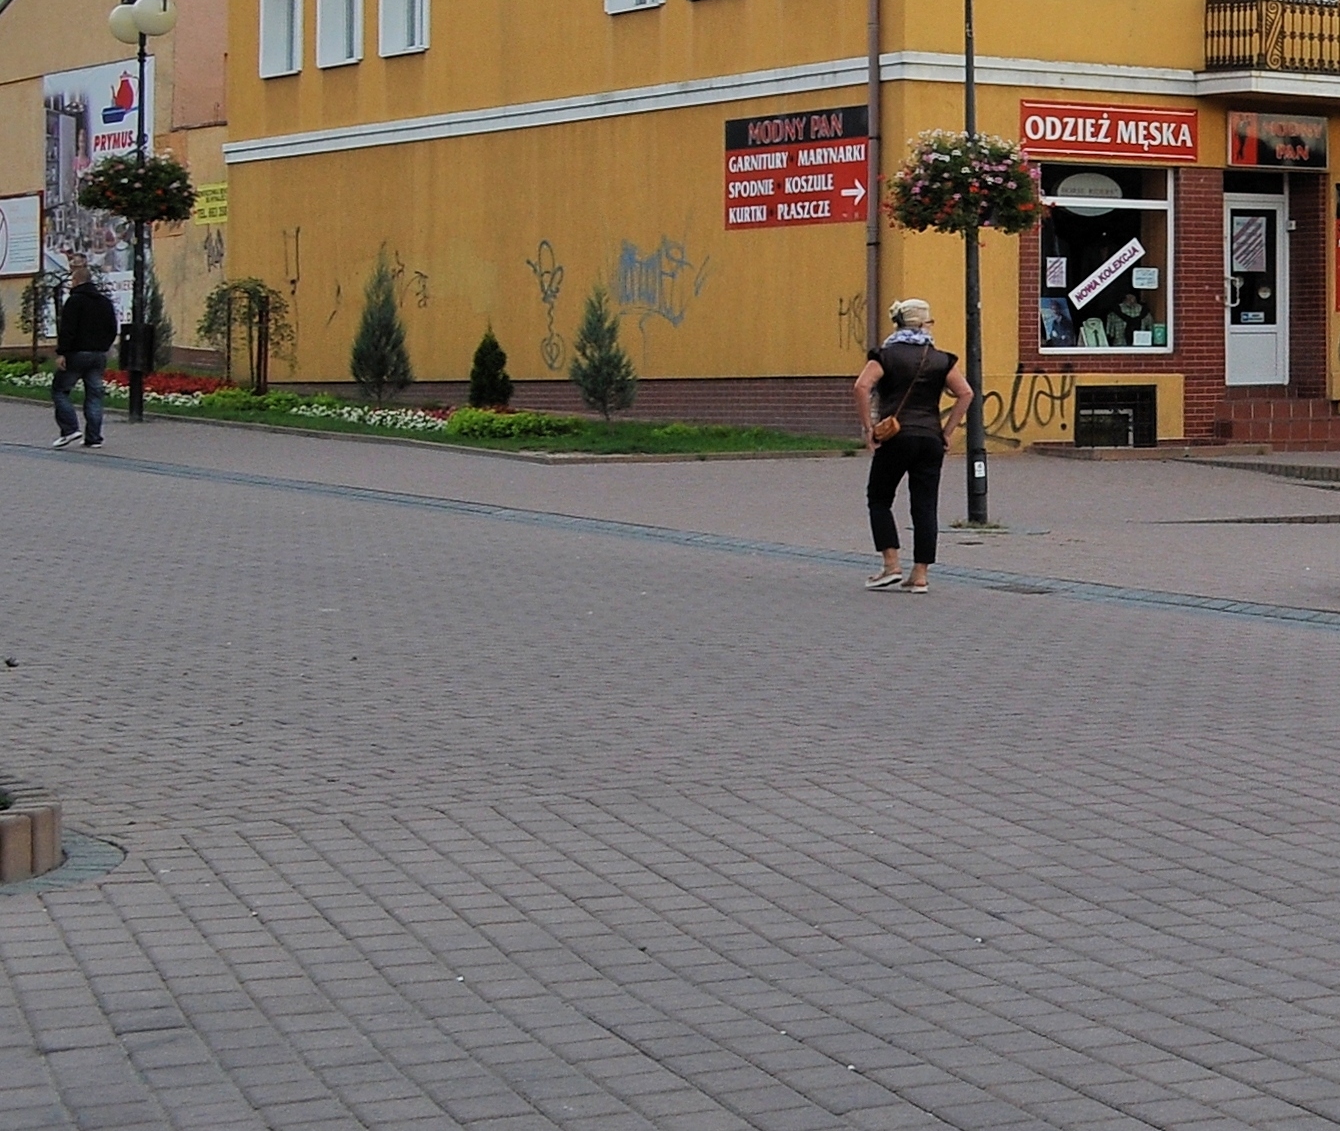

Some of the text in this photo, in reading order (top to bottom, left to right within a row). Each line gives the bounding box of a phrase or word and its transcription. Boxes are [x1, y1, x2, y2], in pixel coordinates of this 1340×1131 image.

[93, 130, 134, 152] PRYMUS
[748, 112, 844, 145] MODNY PAN
[1024, 112, 1194, 152] ODZIEŻ MĘSKA
[728, 143, 866, 173] GARNITURY MARYNARKI
[1275, 143, 1310, 161] PAN
[728, 173, 834, 198] SPODNIE KOSZULE
[728, 200, 831, 224] KURTKI PŁASZCZE
[1075, 245, 1140, 303] NOWA KOLEKCJA
